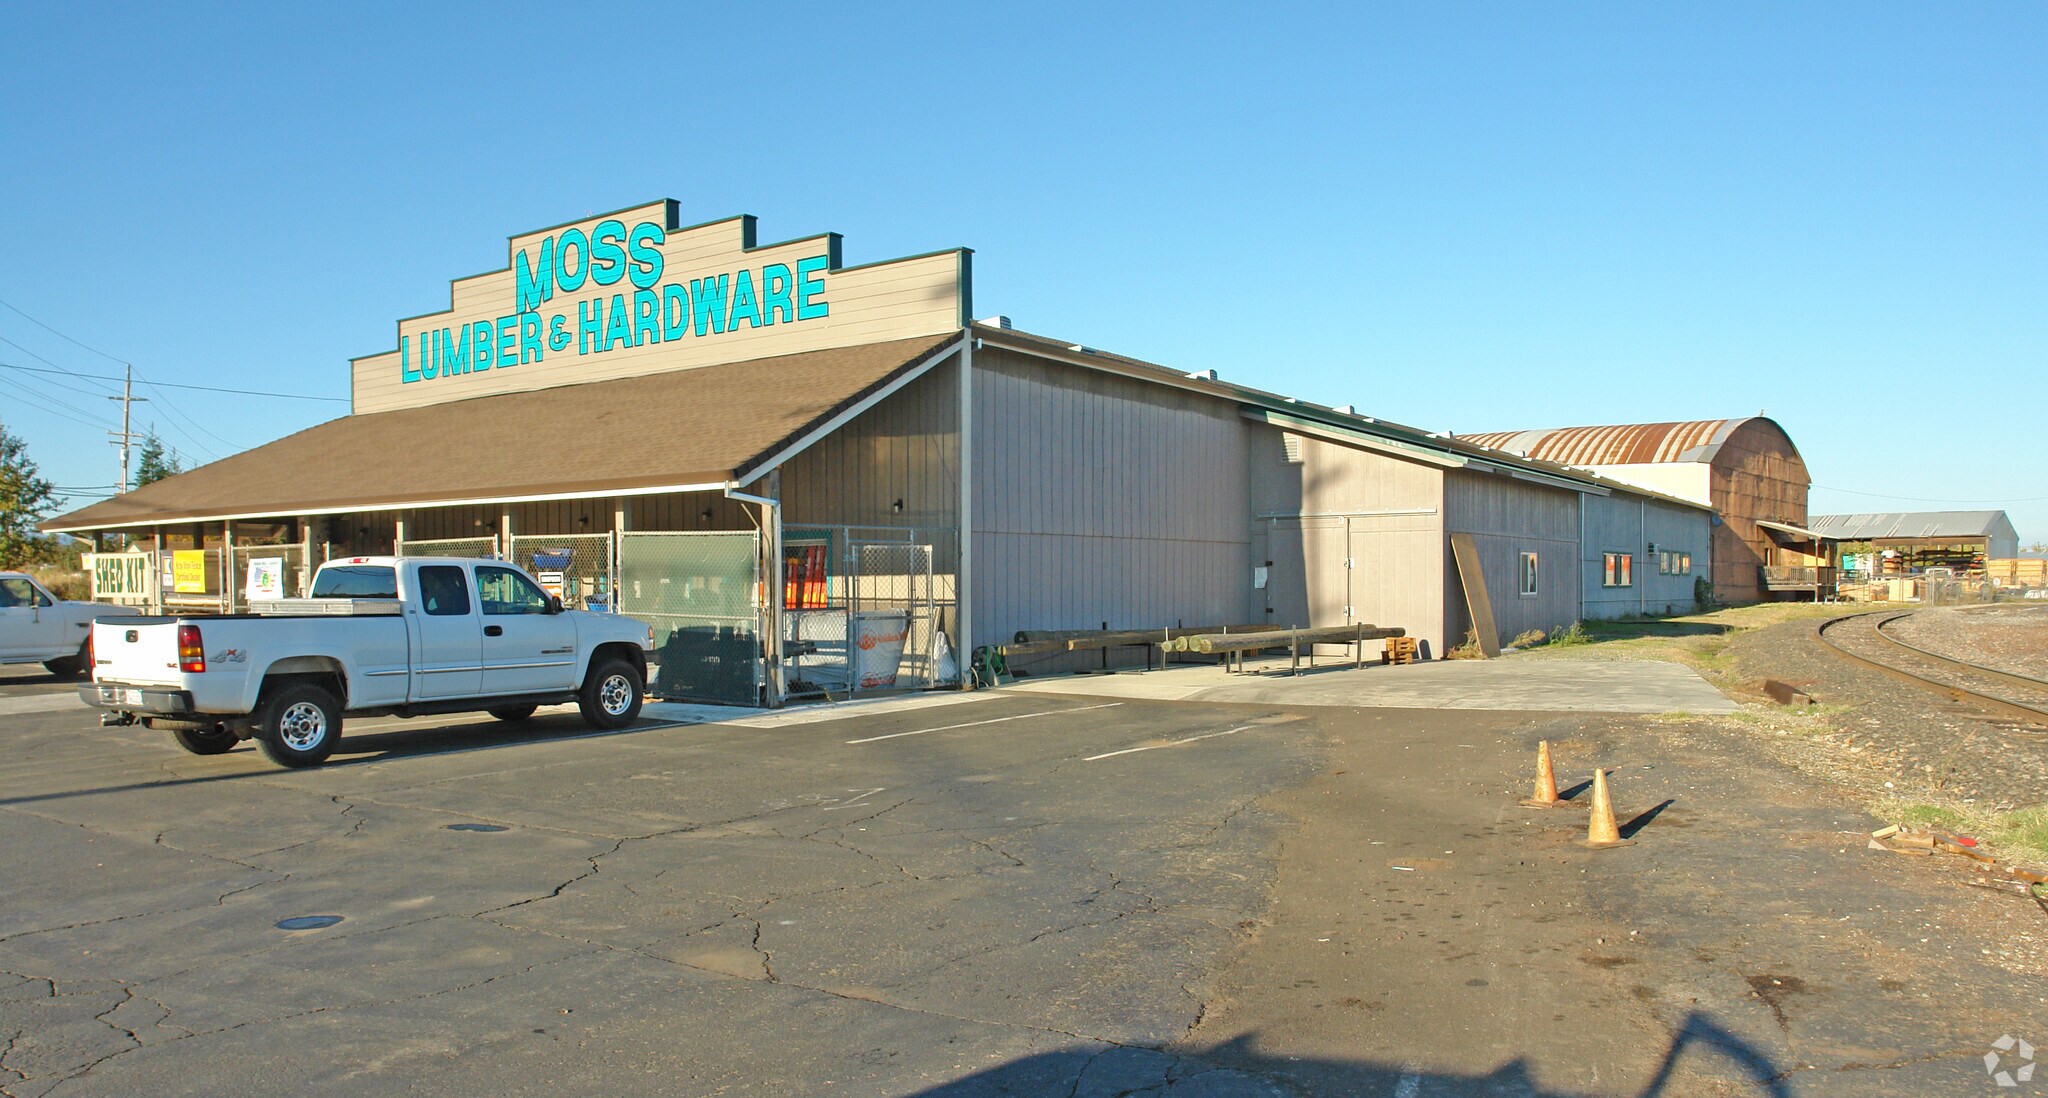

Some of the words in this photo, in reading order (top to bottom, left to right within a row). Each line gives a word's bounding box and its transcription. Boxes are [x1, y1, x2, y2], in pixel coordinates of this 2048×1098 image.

[515, 219, 665, 314] MOSS
[401, 311, 543, 384] LUMBER
[548, 314, 572, 352] &
[578, 255, 830, 356] HARDWARE
[95, 557, 123, 594] SHED
[126, 557, 145, 594] KIT
